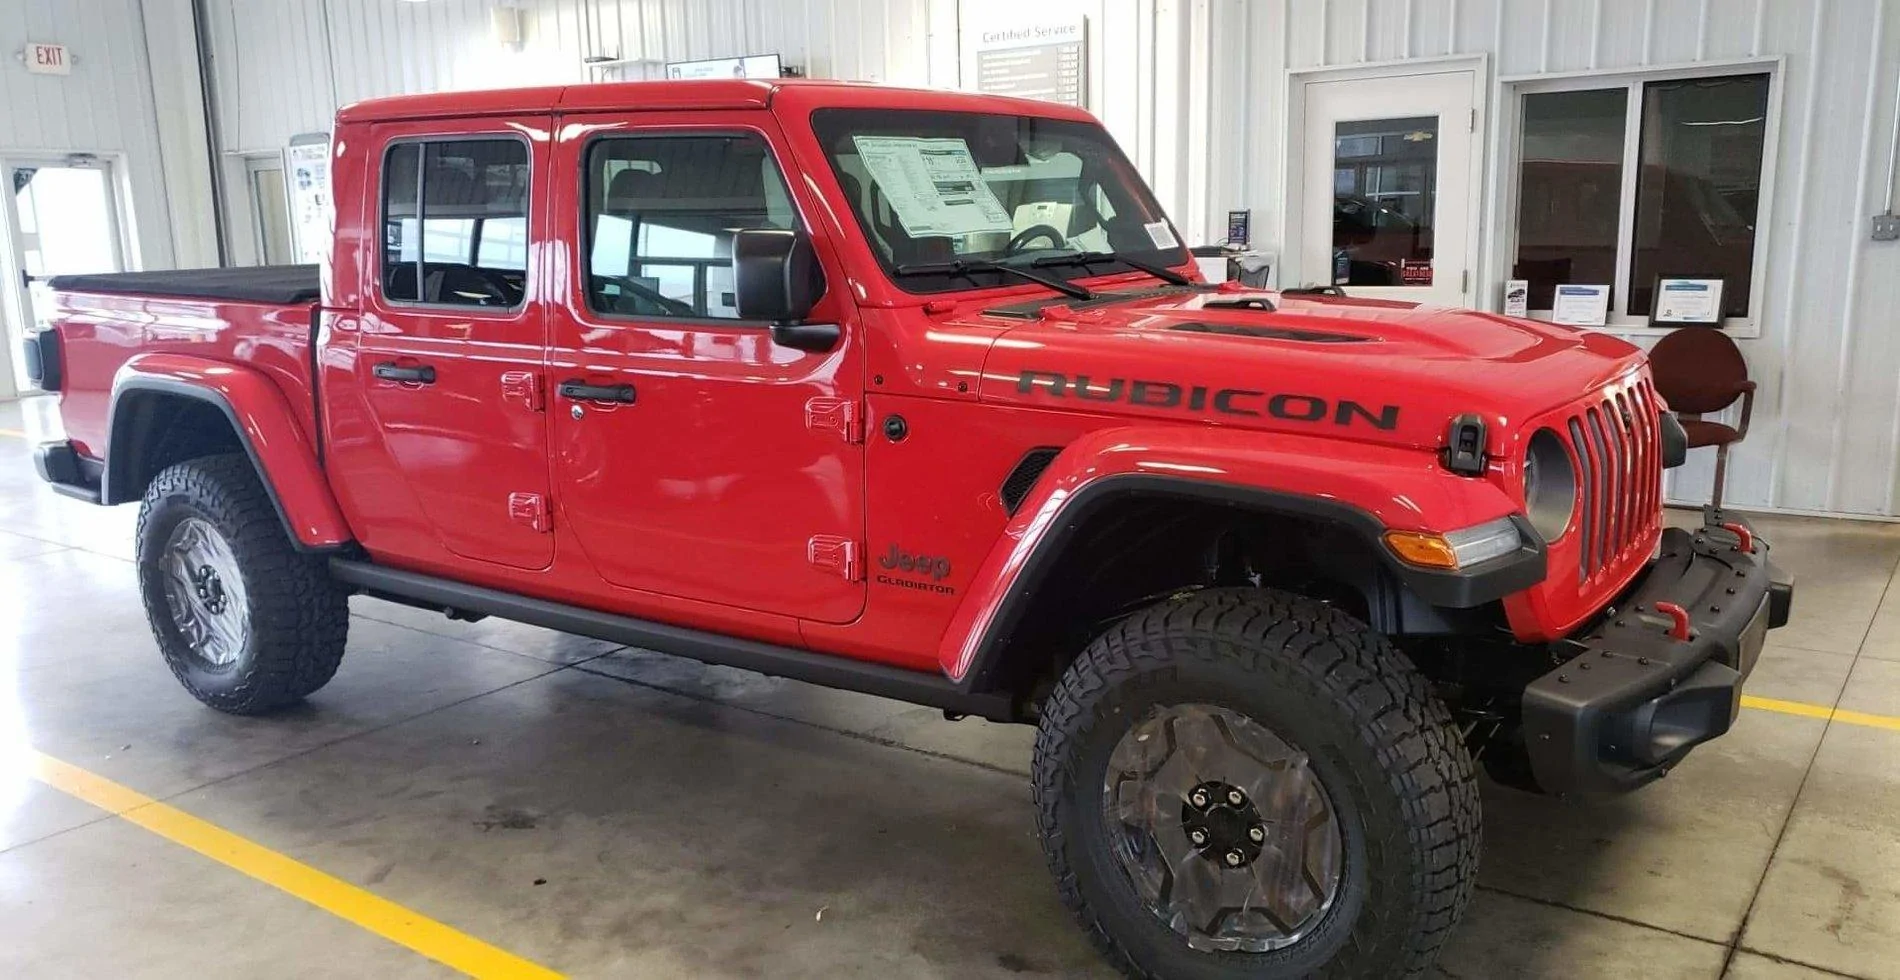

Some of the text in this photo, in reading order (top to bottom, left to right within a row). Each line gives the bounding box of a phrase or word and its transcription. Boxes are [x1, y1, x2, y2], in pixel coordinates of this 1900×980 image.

[983, 24, 1076, 43] Certified Service
[36, 46, 62, 66] EXIT
[1017, 370, 1400, 430] RUBICON
[879, 543, 951, 581] Jeep
[877, 575, 955, 595] GLADIATOR
